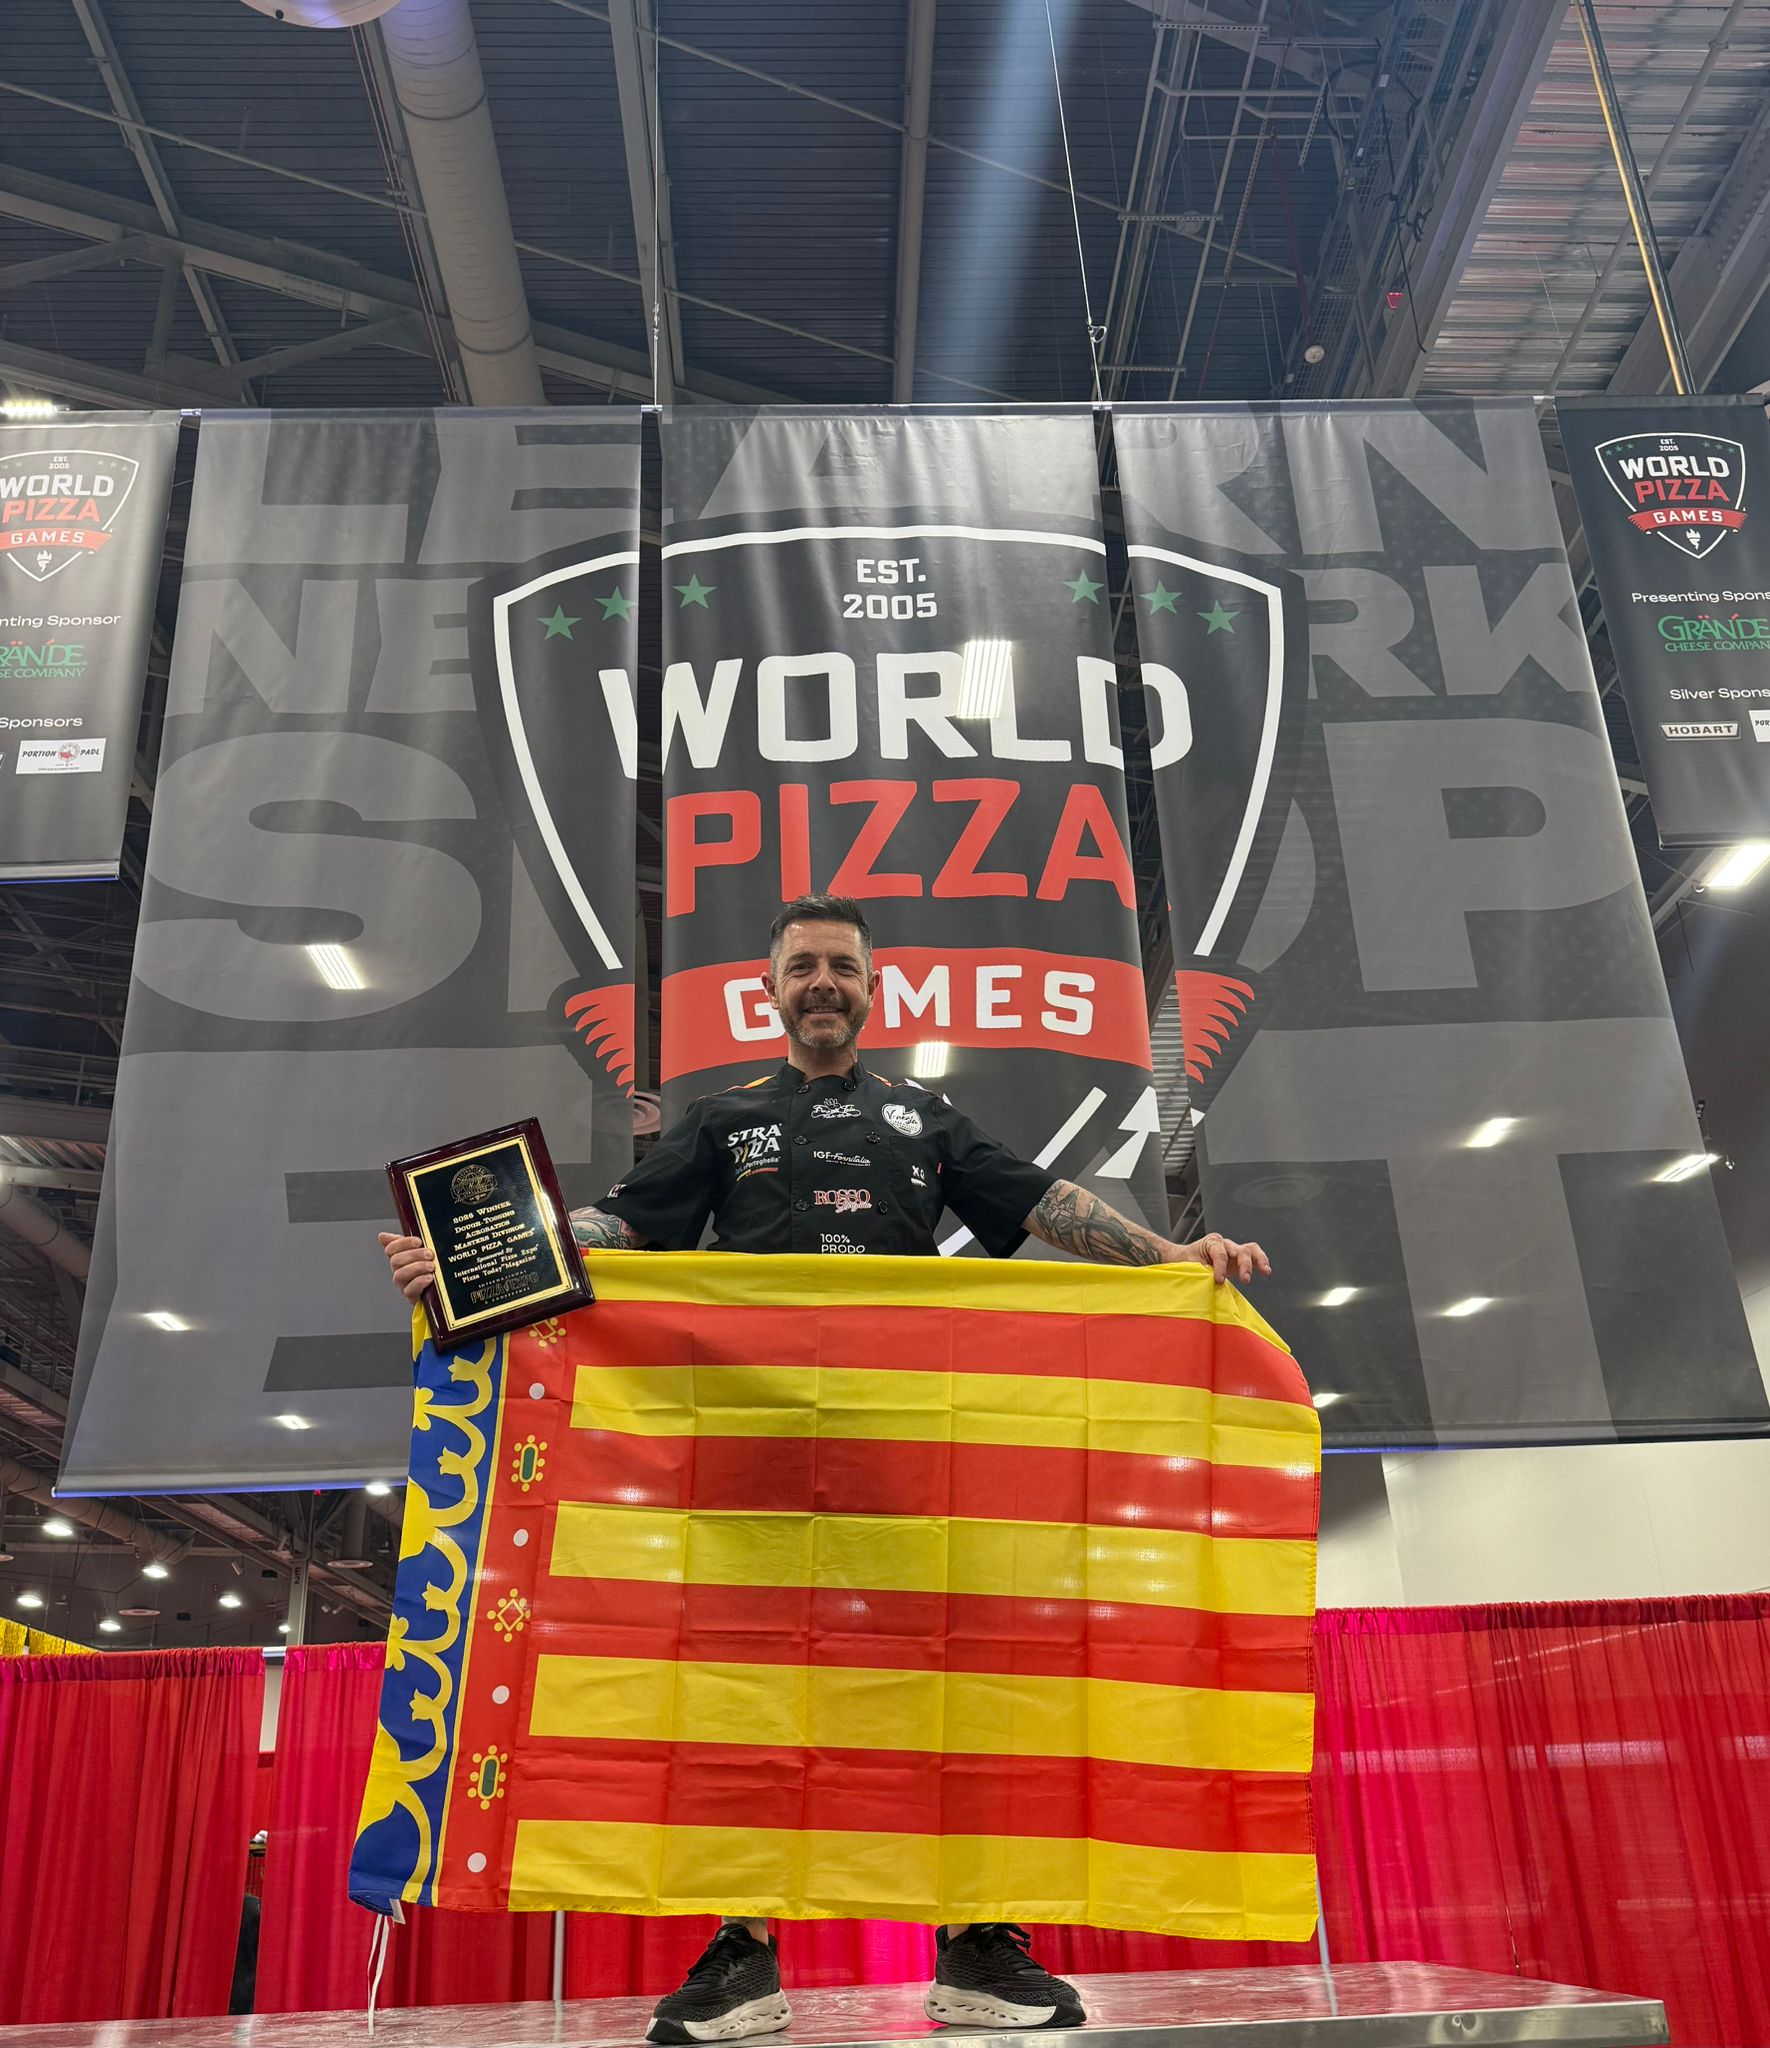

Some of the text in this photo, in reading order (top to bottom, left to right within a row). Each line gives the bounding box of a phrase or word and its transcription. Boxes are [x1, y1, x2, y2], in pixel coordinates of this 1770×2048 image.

[1618, 456, 1730, 480] WORLD
[0, 474, 114, 499] WORLD
[1634, 479, 1730, 504] PIZZA
[2, 498, 101, 524] PIZZA
[1653, 510, 1723, 524] GAMES
[11, 531, 85, 545] GAMES
[856, 558, 927, 584] EST.
[1631, 591, 1719, 603] Presenting
[842, 592, 938, 619] 2005
[47, 615, 121, 627] Sponsor
[1665, 641, 1712, 652] CHEESE
[14, 667, 86, 679] COMPANY
[1670, 689, 1715, 700] Silver
[599, 651, 1193, 779] WORLD
[0, 717, 83, 730] Sponsors
[1669, 725, 1733, 734] HOBART
[22, 750, 57, 758] PORTION
[667, 779, 1172, 918] PIZZA
[723, 964, 1095, 1042] GMES
[727, 1124, 782, 1148] STRA
[813, 1189, 871, 1205] ROSSO
[820, 1233, 850, 1244] 100%
[448, 1248, 477, 1262] WORLD
[481, 1240, 502, 1252] PIZZA
[821, 1245, 866, 1254] PRODO
